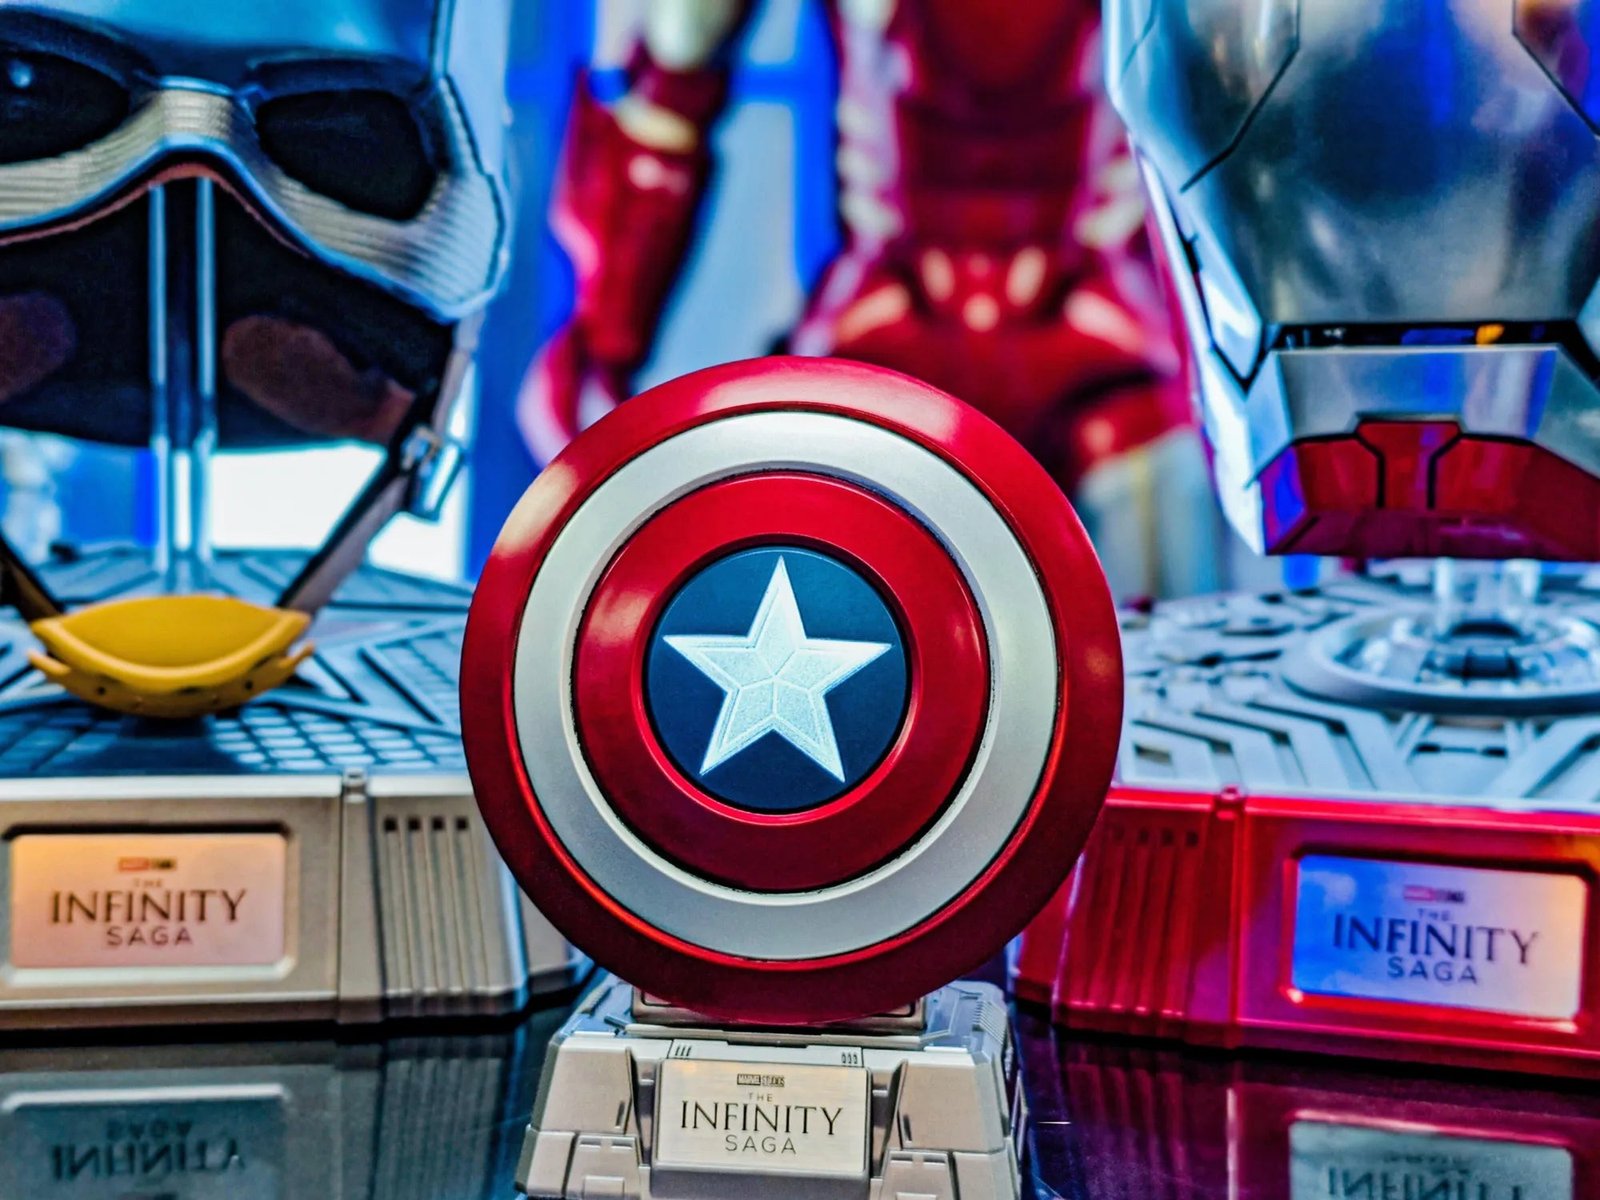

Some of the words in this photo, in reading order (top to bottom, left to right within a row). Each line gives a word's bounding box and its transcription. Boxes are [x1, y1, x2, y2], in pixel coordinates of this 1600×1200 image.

[50, 889, 246, 923] INFINITY
[106, 926, 192, 946] SAGA
[1333, 913, 1540, 965] INFINITY
[1387, 957, 1478, 984] SAGA
[749, 1093, 773, 1102] THE
[681, 1101, 843, 1135] INFINITY
[725, 1134, 796, 1154] SAGA
